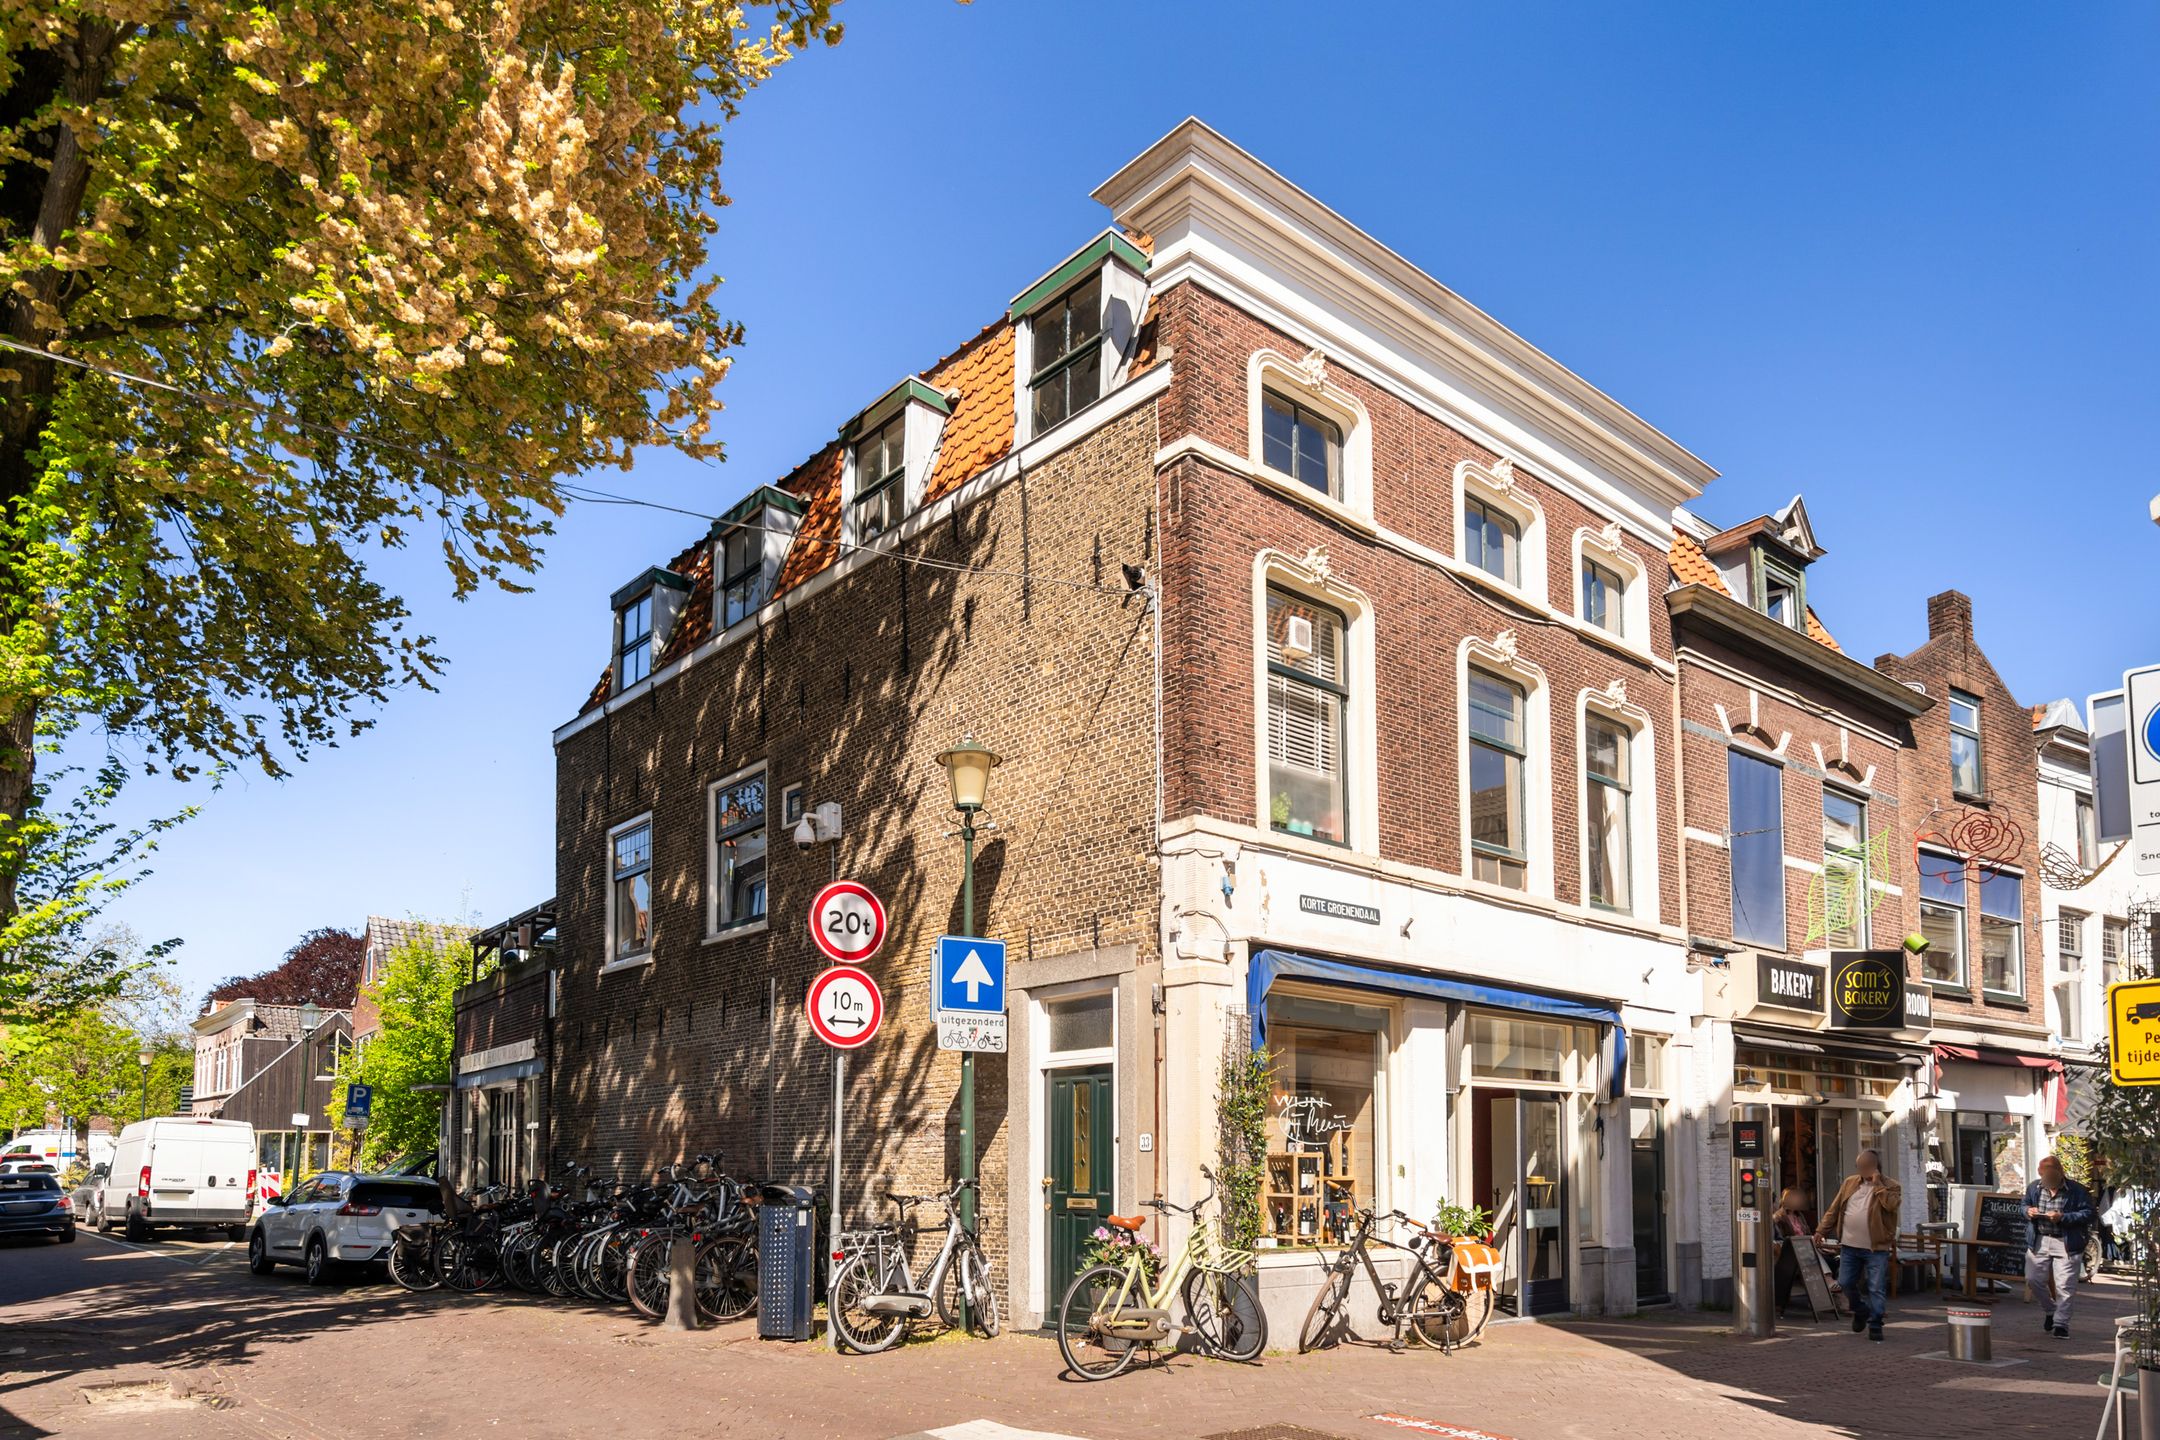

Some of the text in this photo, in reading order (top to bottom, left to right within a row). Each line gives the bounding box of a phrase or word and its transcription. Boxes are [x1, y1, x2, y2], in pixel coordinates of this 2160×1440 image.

[1301, 896, 1379, 922] KORTE GROENENDAAL
[1771, 968, 1813, 999] BAKERY
[1906, 992, 1930, 1017] ROOM
[941, 1016, 1004, 1027] uitgezonderd
[352, 1087, 367, 1103] P
[1273, 1094, 1323, 1108] WIJN
[1141, 1136, 1150, 1148] 33
